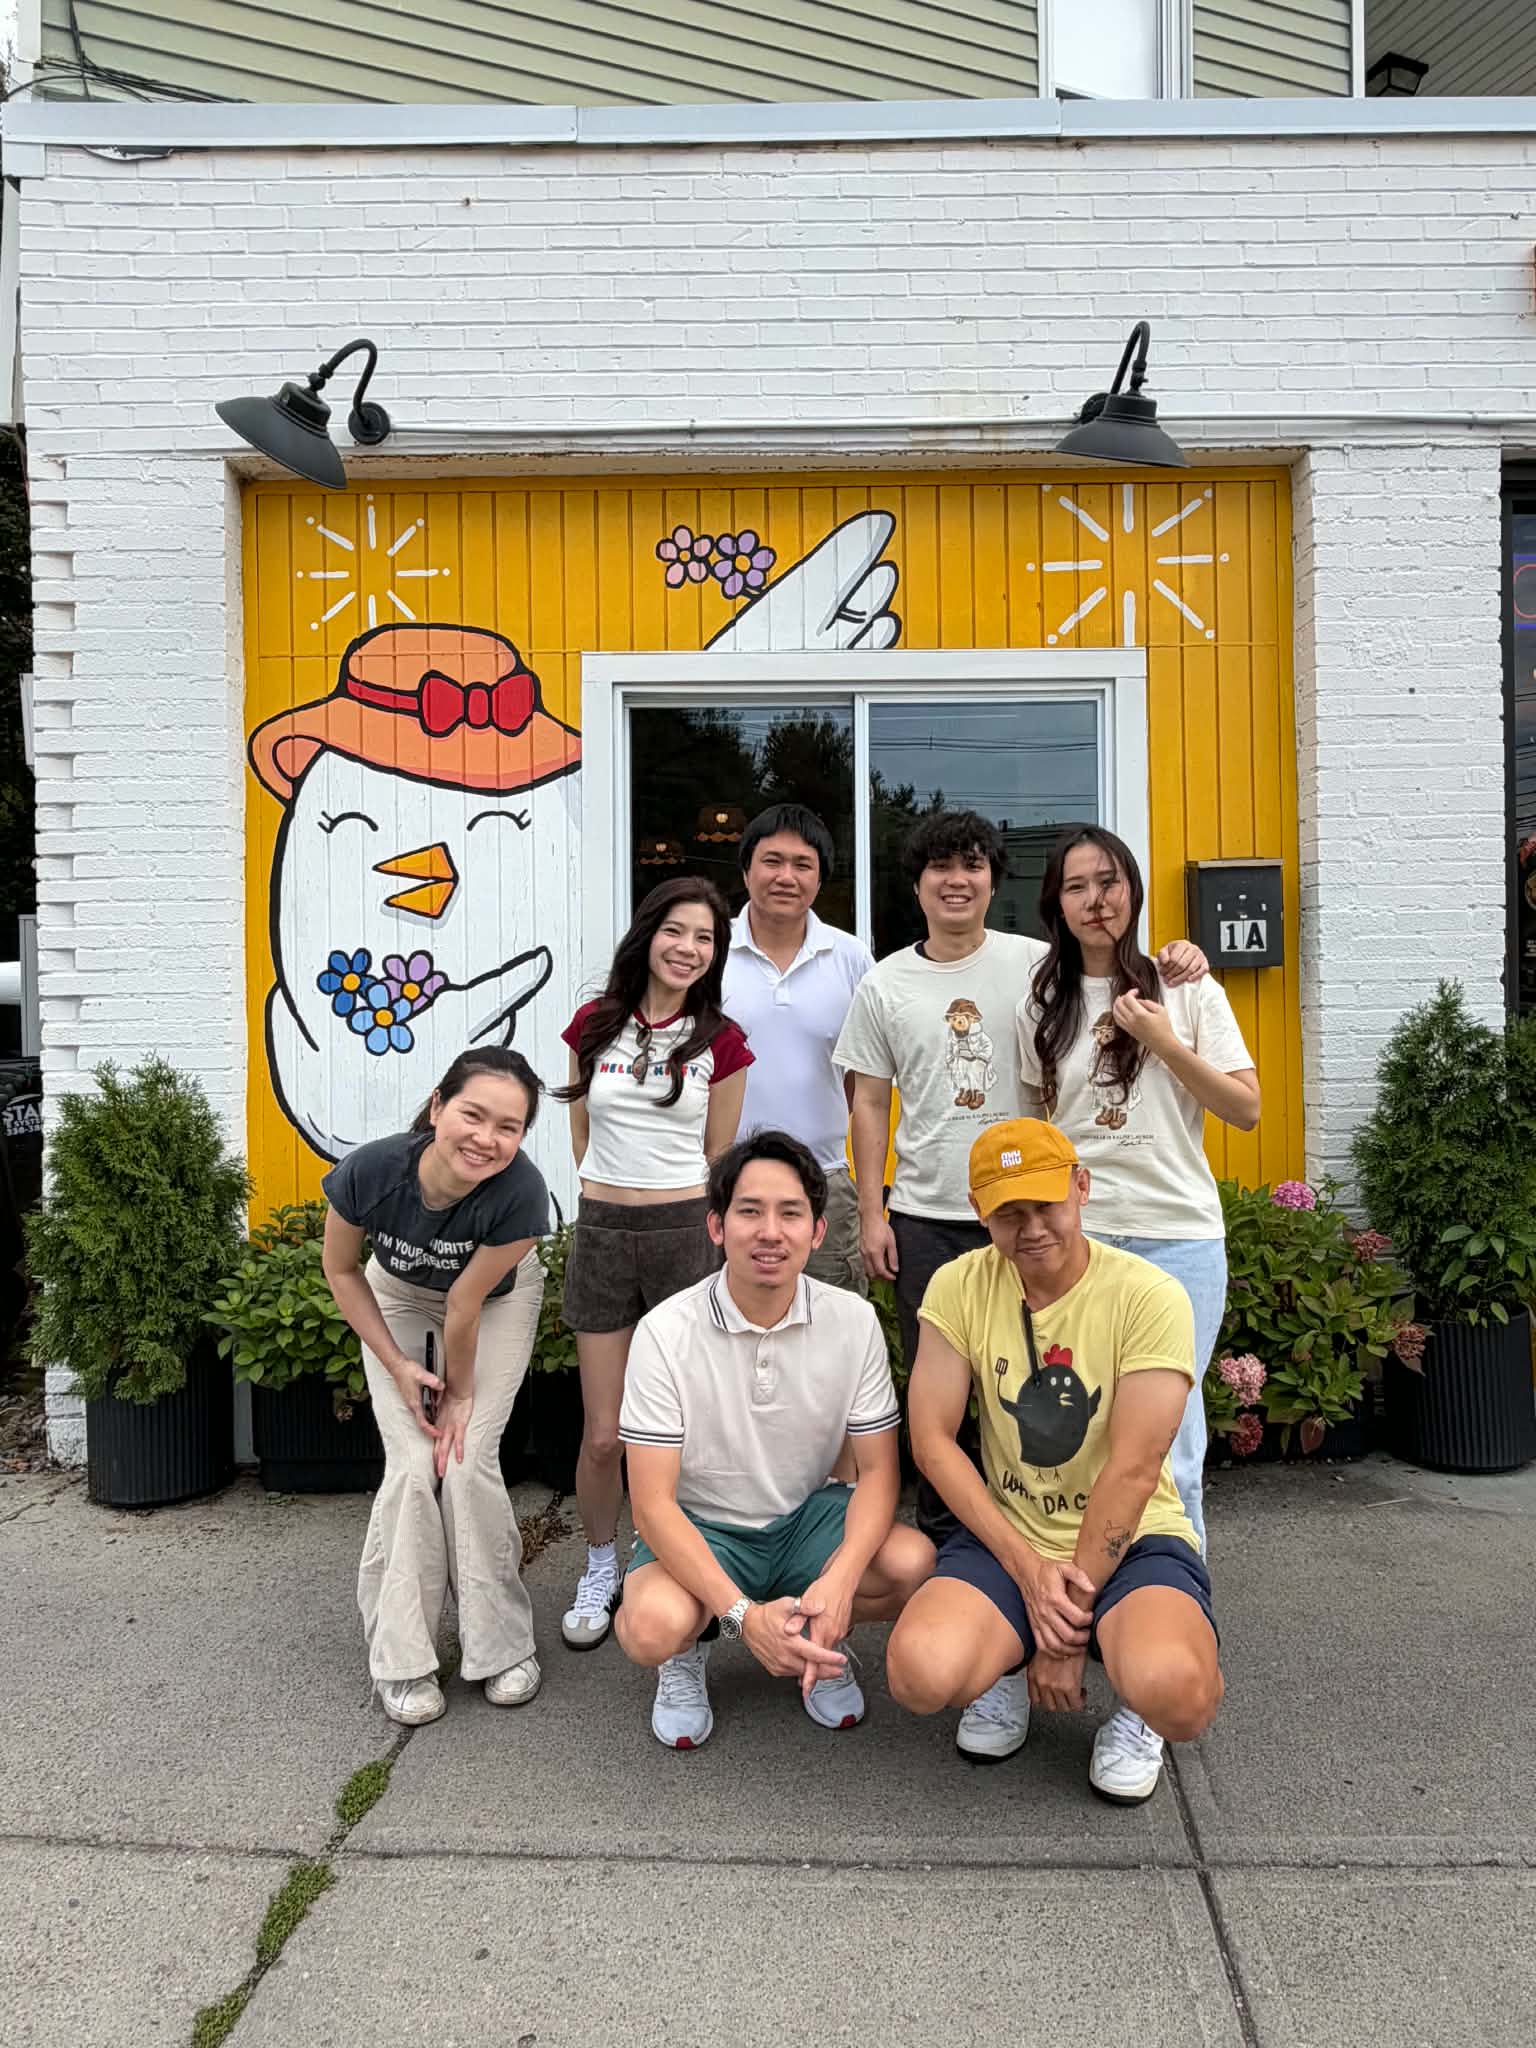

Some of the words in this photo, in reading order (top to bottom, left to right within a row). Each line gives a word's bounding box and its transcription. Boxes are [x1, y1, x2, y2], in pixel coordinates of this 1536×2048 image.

[1225, 921, 1265, 950] 1A
[654, 1063, 698, 1078] KITY
[377, 1231, 393, 1249] I'M
[1043, 1493, 1069, 1515] DA
[1074, 1492, 1090, 1510] C
